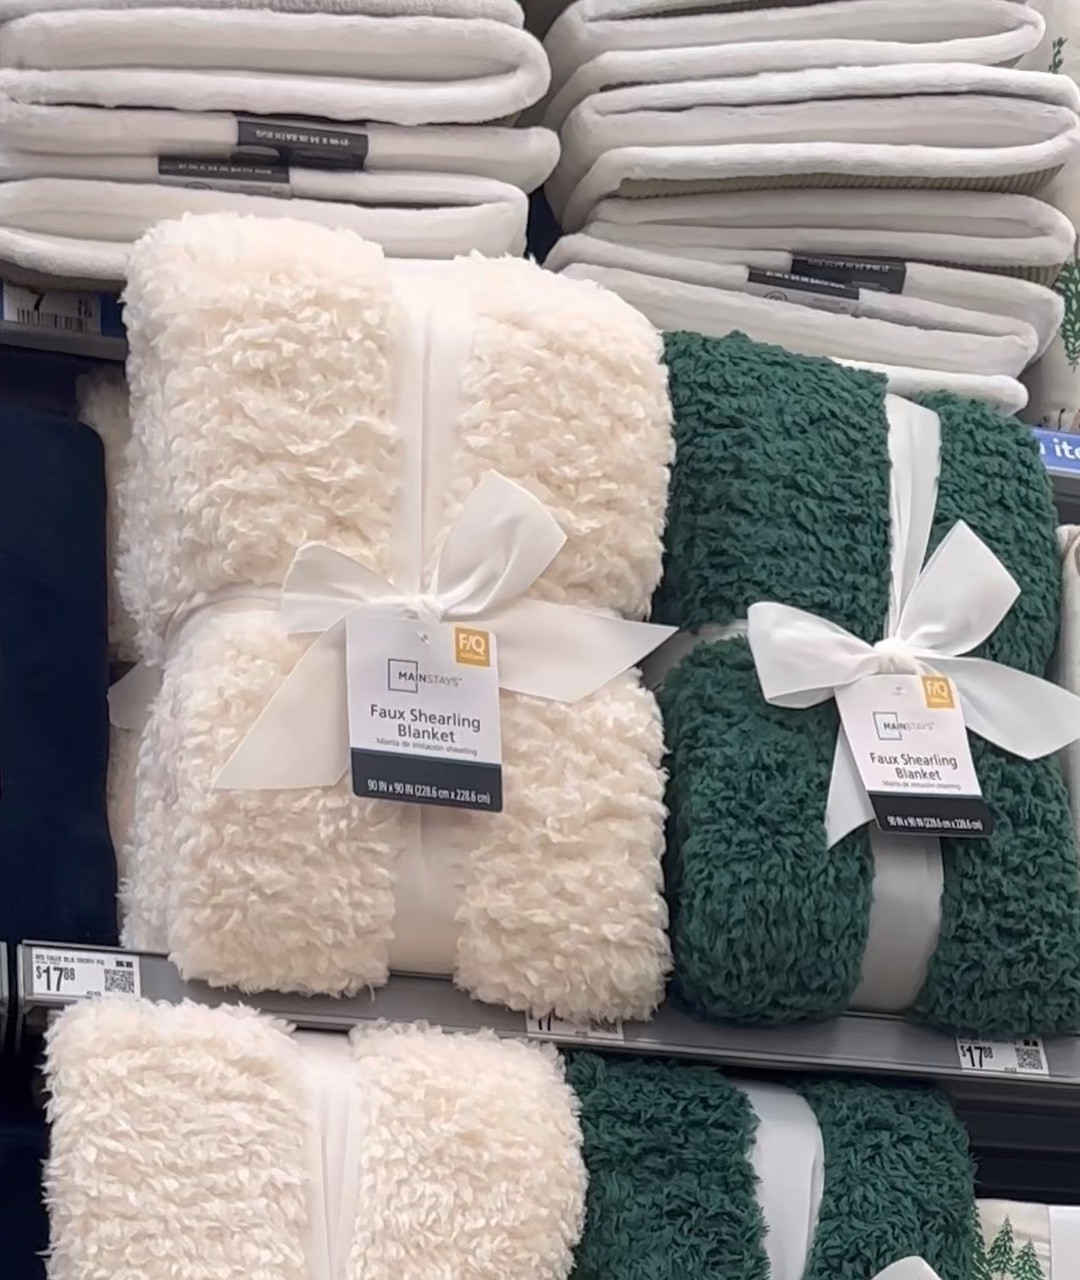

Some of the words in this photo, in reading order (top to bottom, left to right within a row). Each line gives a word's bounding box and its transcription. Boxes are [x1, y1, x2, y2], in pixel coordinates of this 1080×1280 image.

[371, 704, 405, 720] Faux
[410, 708, 481, 733] Shearling
[398, 724, 455, 743] Blanket
[870, 752, 899, 765] Faux
[900, 753, 958, 769] Shearling
[895, 767, 942, 781] Blanket
